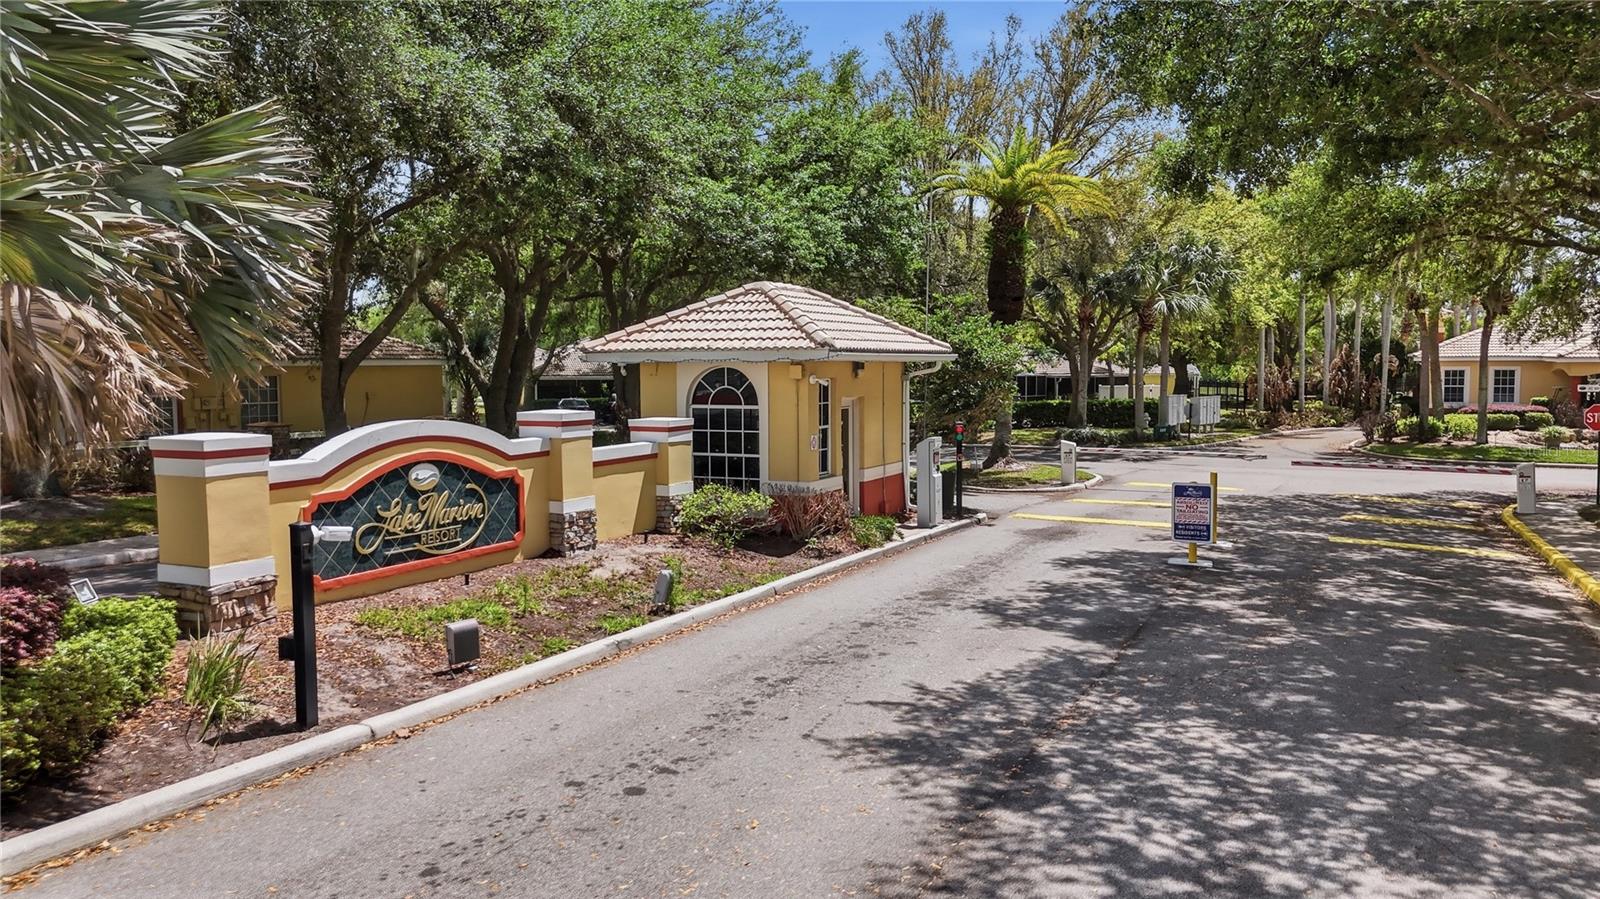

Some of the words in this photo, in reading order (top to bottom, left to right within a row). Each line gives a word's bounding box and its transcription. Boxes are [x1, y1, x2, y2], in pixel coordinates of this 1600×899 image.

[1587, 413, 1600, 423] ST
[417, 490, 484, 532] Marion
[421, 527, 461, 545] RESORT
